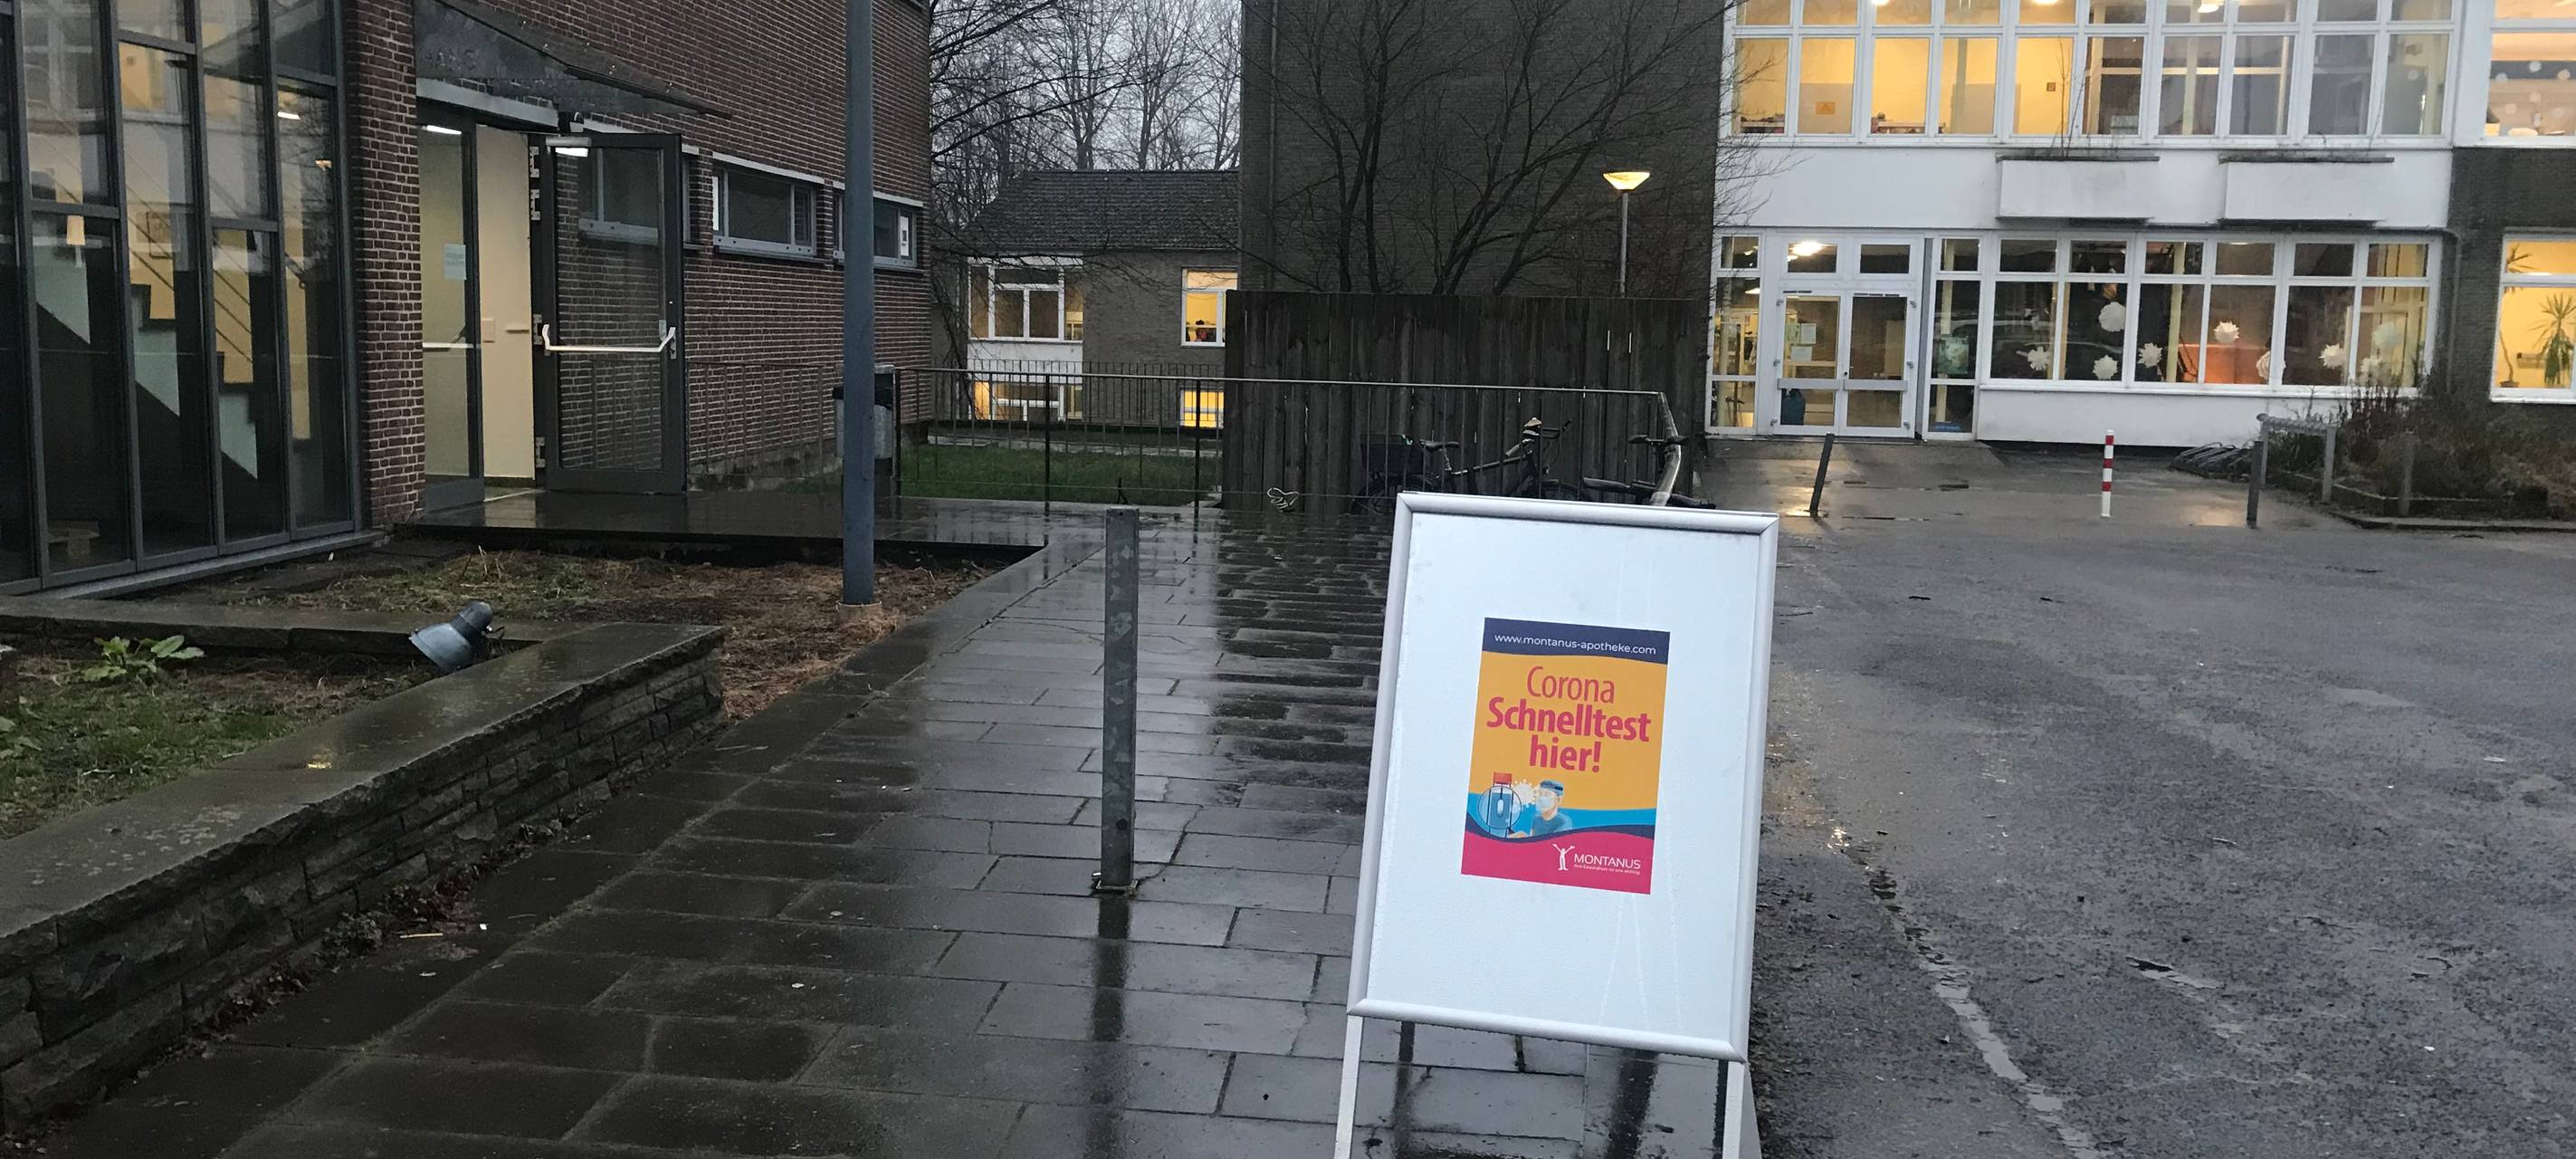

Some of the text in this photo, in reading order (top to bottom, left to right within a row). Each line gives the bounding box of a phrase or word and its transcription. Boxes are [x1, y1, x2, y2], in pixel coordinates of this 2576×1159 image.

[1494, 635, 1656, 655] www.montanus-apotheke.com
[1527, 666, 1615, 704] Corona
[1486, 696, 1652, 742] Schnelltest
[1529, 734, 1602, 773] hier!
[1574, 853, 1642, 869] MONTANUS
